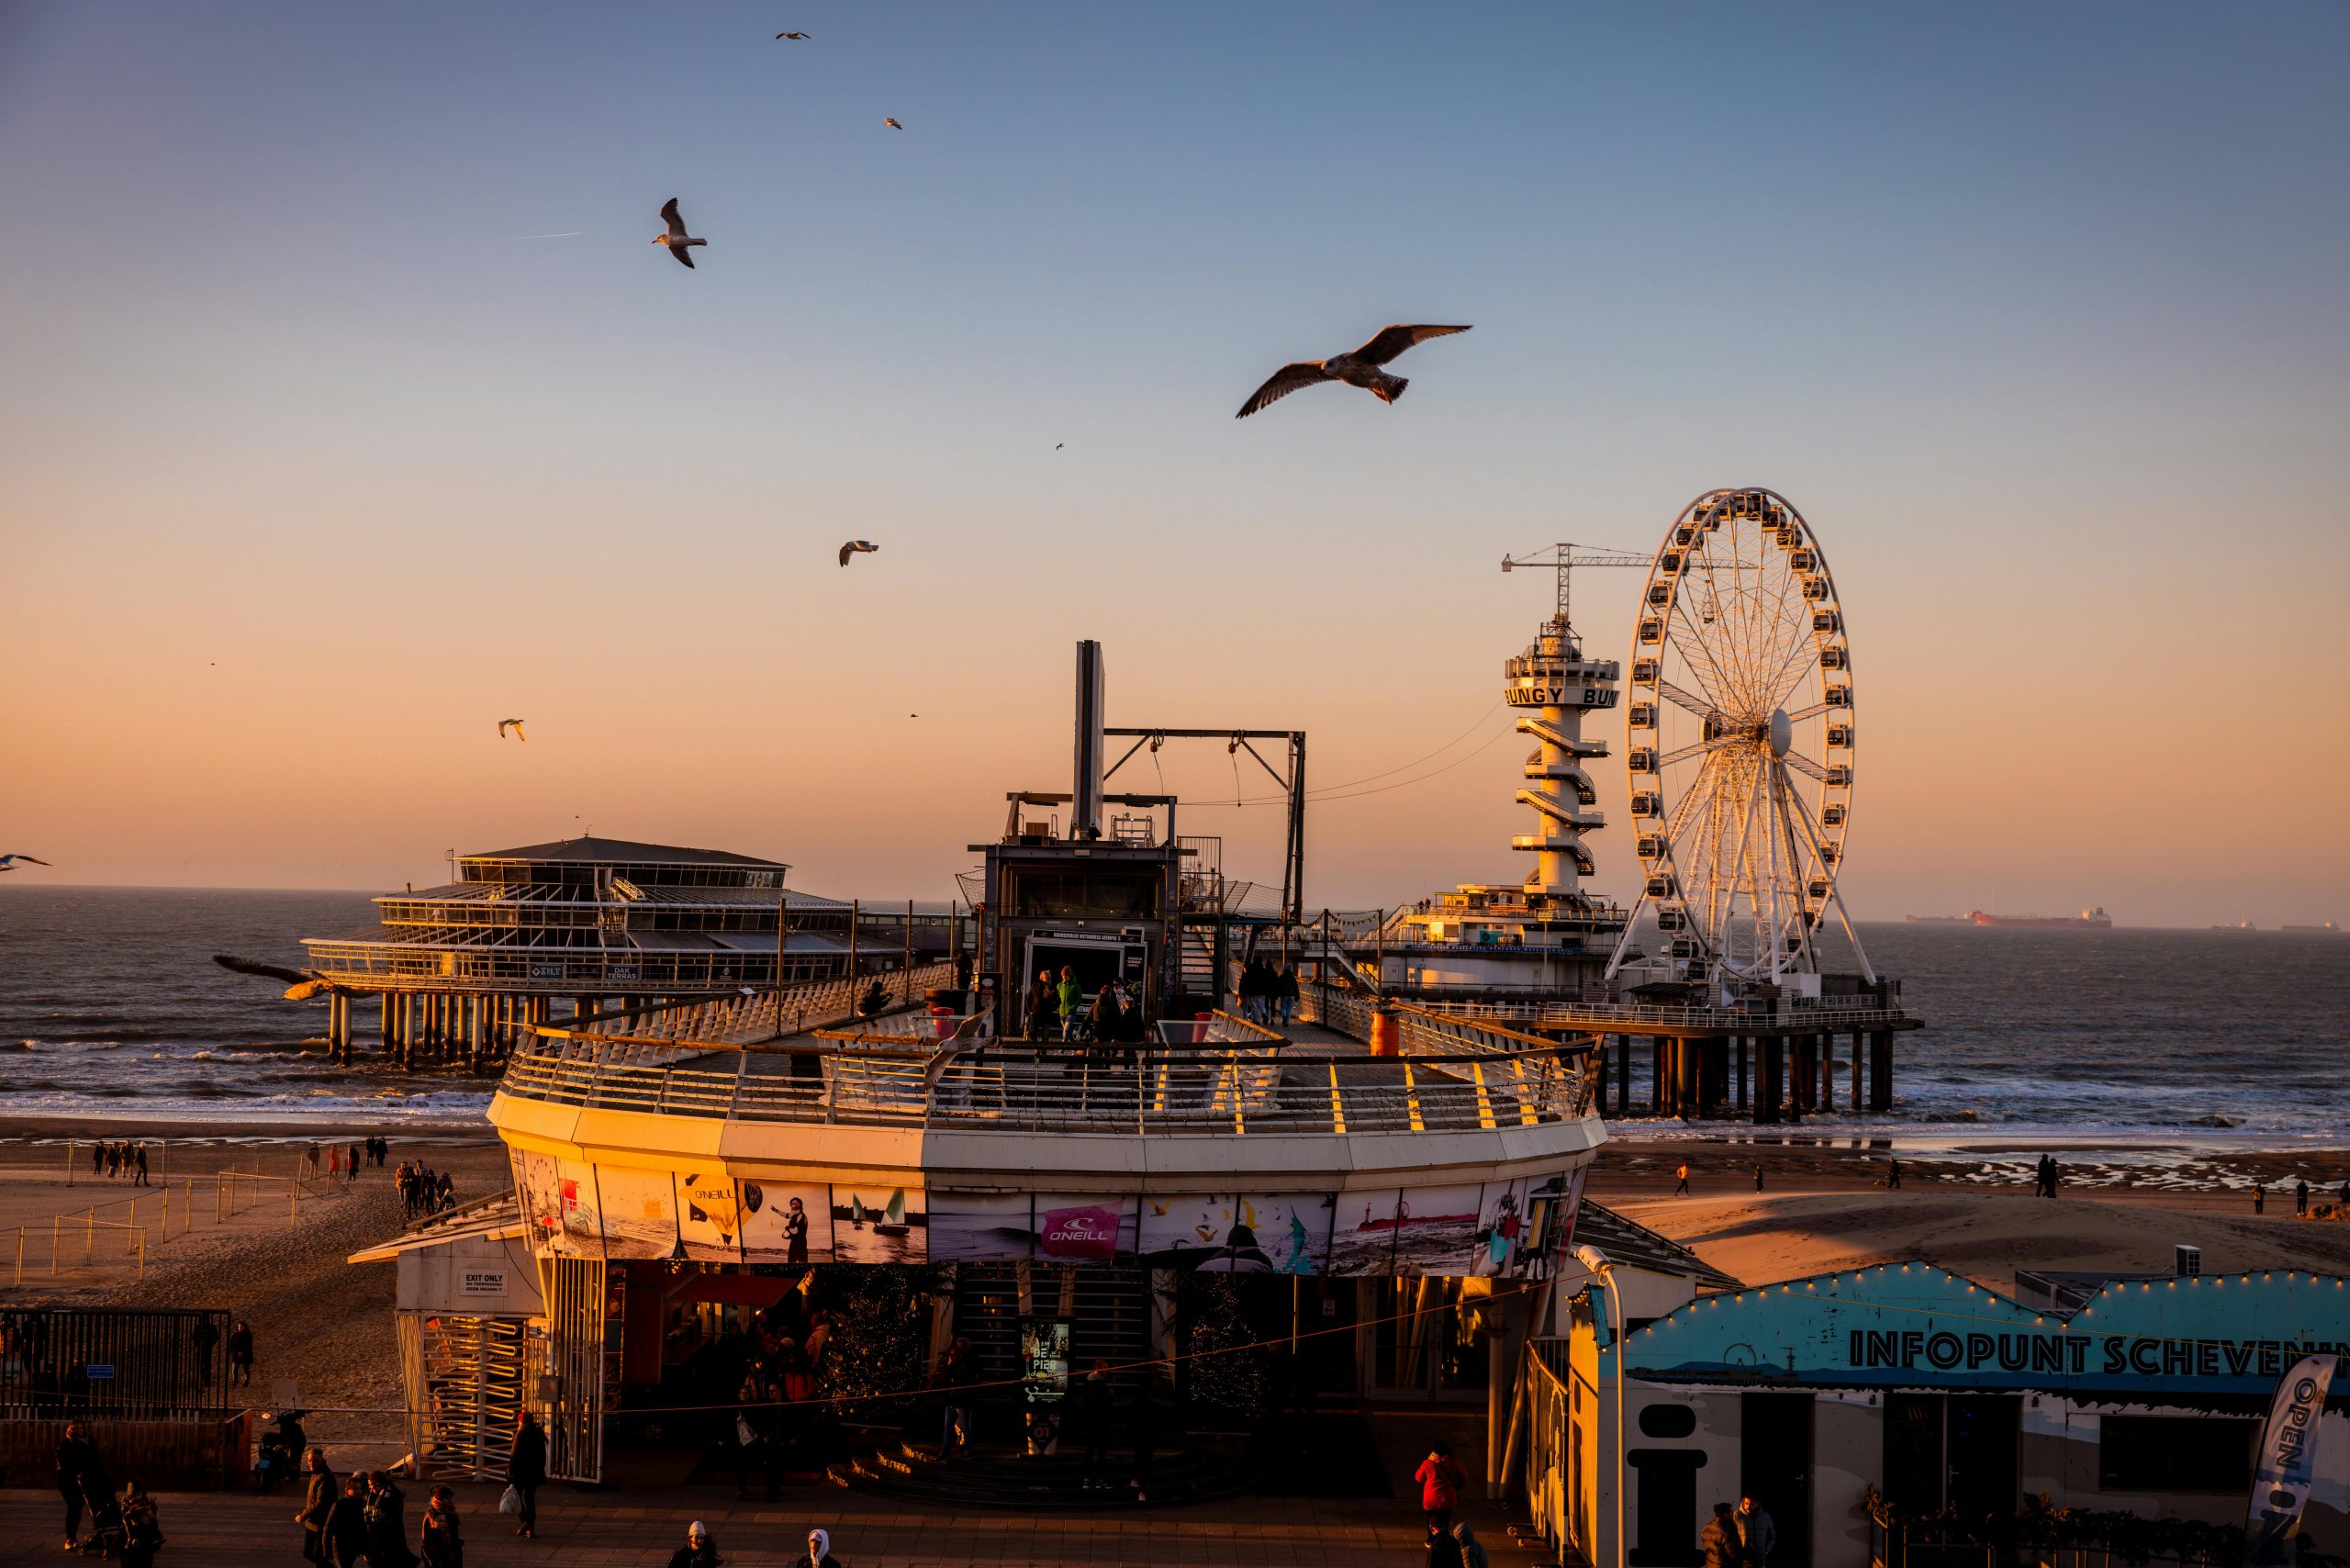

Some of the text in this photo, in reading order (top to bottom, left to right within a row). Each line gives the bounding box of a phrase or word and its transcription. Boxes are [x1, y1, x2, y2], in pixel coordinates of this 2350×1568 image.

[540, 967, 562, 976] ZILT
[695, 1189, 736, 1200] O'NEILL
[1049, 1230, 1109, 1241] O'NEILL
[1033, 1348, 1047, 1358] DE
[1850, 1329, 2350, 1378] INFOPUNT SCHEVEN
[1033, 1360, 1058, 1370] PIER
[2276, 1377, 2318, 1472] OPEN
